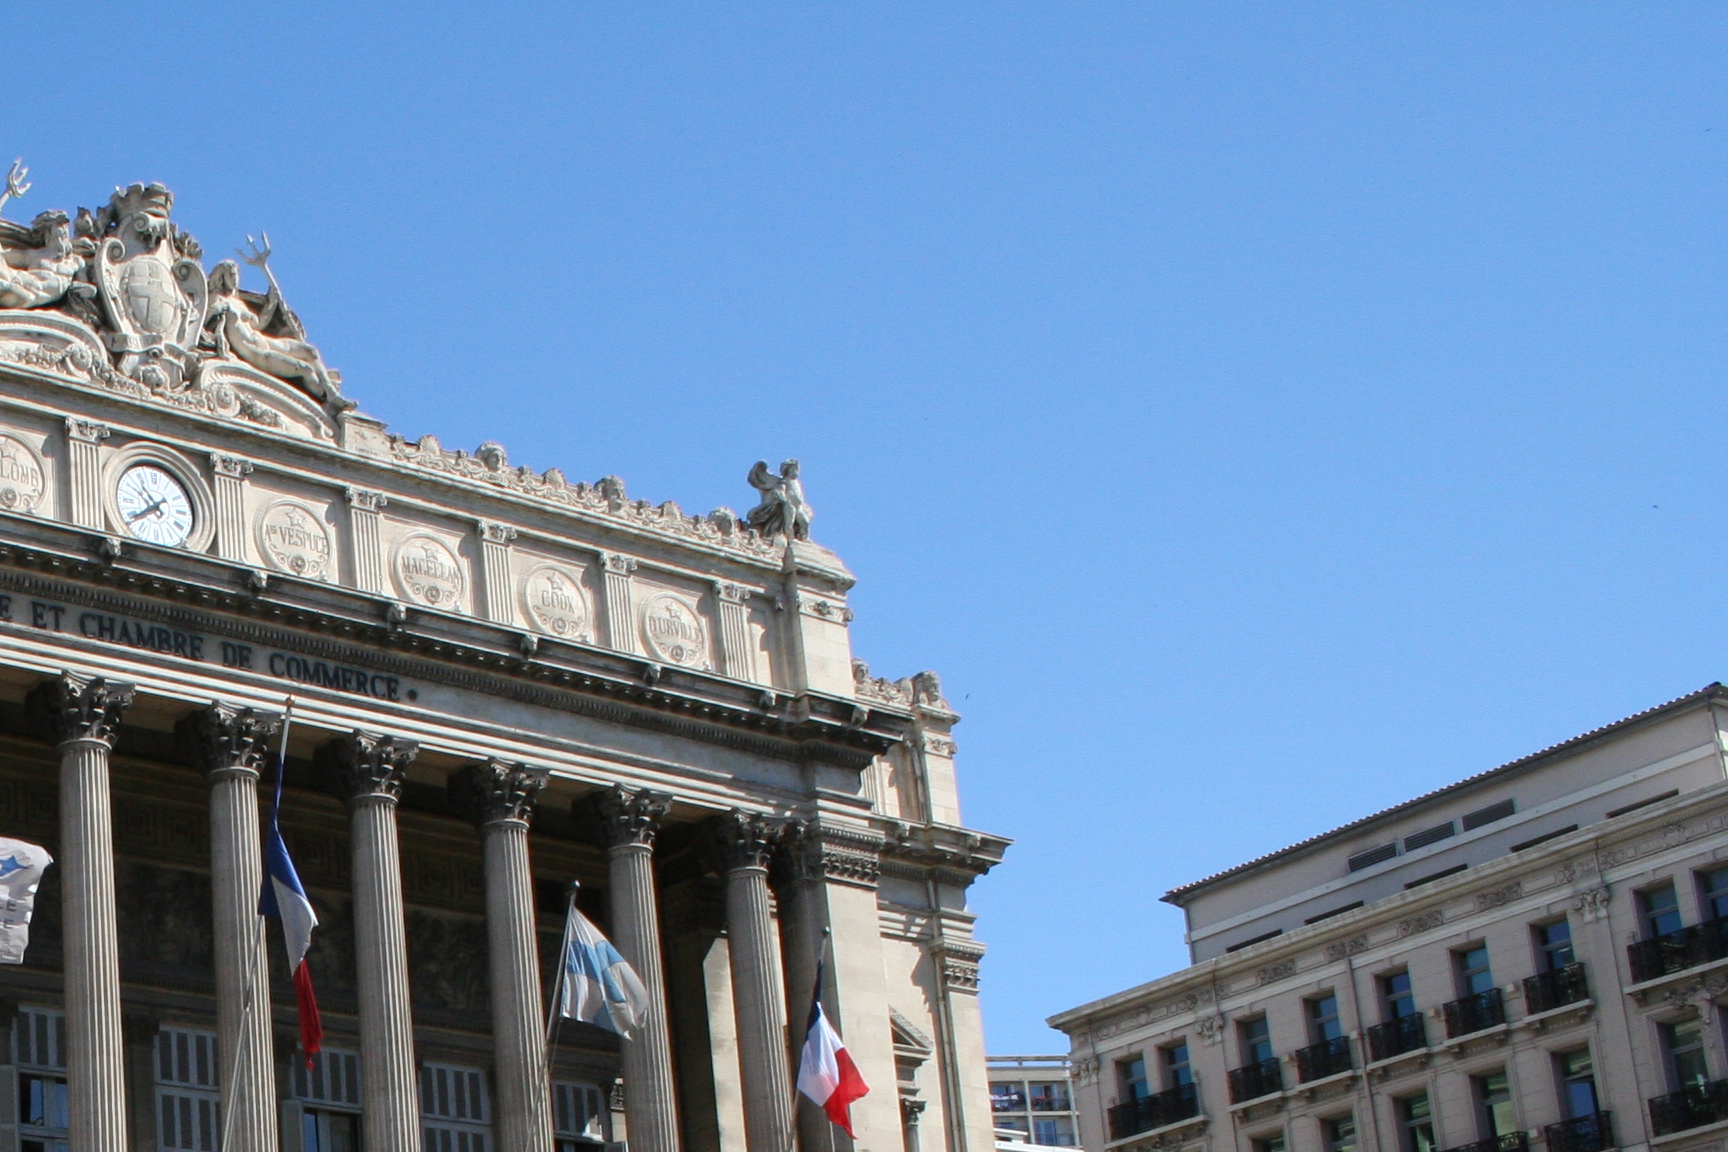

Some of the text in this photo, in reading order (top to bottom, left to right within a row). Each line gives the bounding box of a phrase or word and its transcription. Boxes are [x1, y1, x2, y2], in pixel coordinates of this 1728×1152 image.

[402, 556, 460, 585] MAGELLAN
[541, 591, 575, 614] COOK
[31, 602, 66, 633] ET
[78, 612, 205, 661] CHAMBRE
[223, 641, 253, 670] DE
[268, 650, 401, 701] COMMERCE
